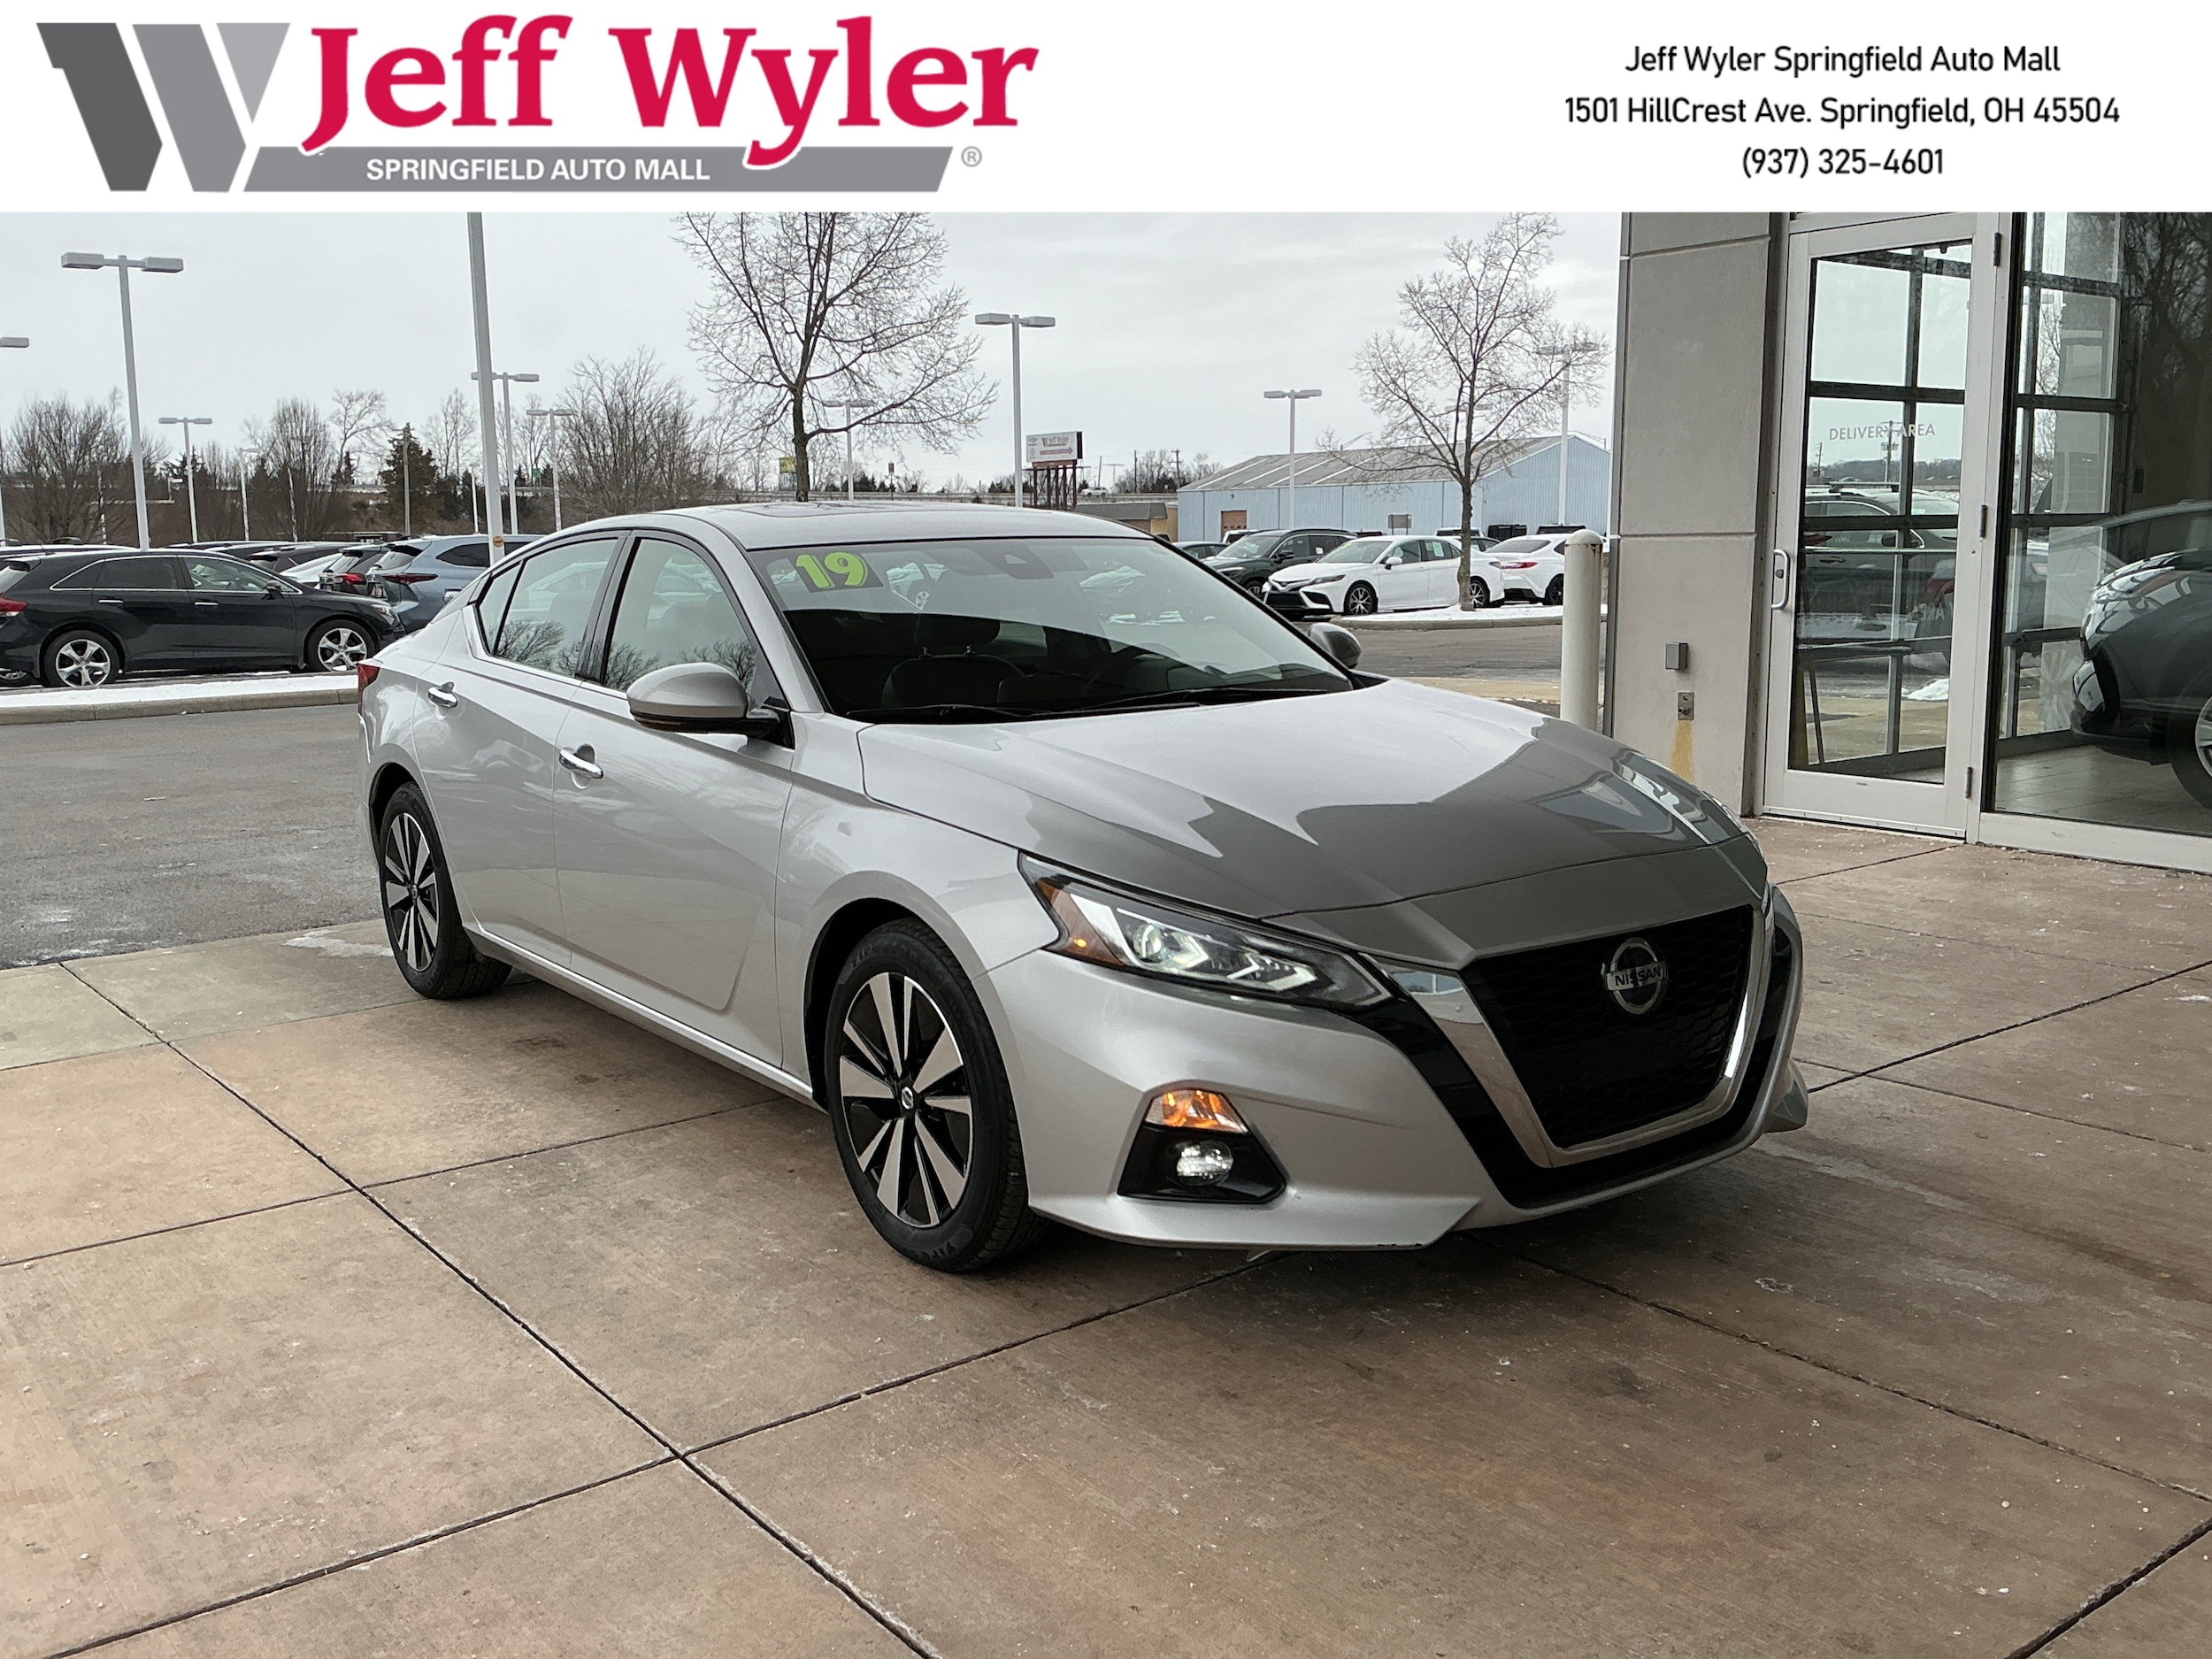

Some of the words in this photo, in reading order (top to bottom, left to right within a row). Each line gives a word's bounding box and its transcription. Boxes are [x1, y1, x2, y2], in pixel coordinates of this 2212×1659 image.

[1830, 426, 1892, 440] DELIVERY
[1899, 424, 1935, 437] AREA
[795, 551, 869, 589] 19
[1615, 967, 1661, 986] NISSAN
